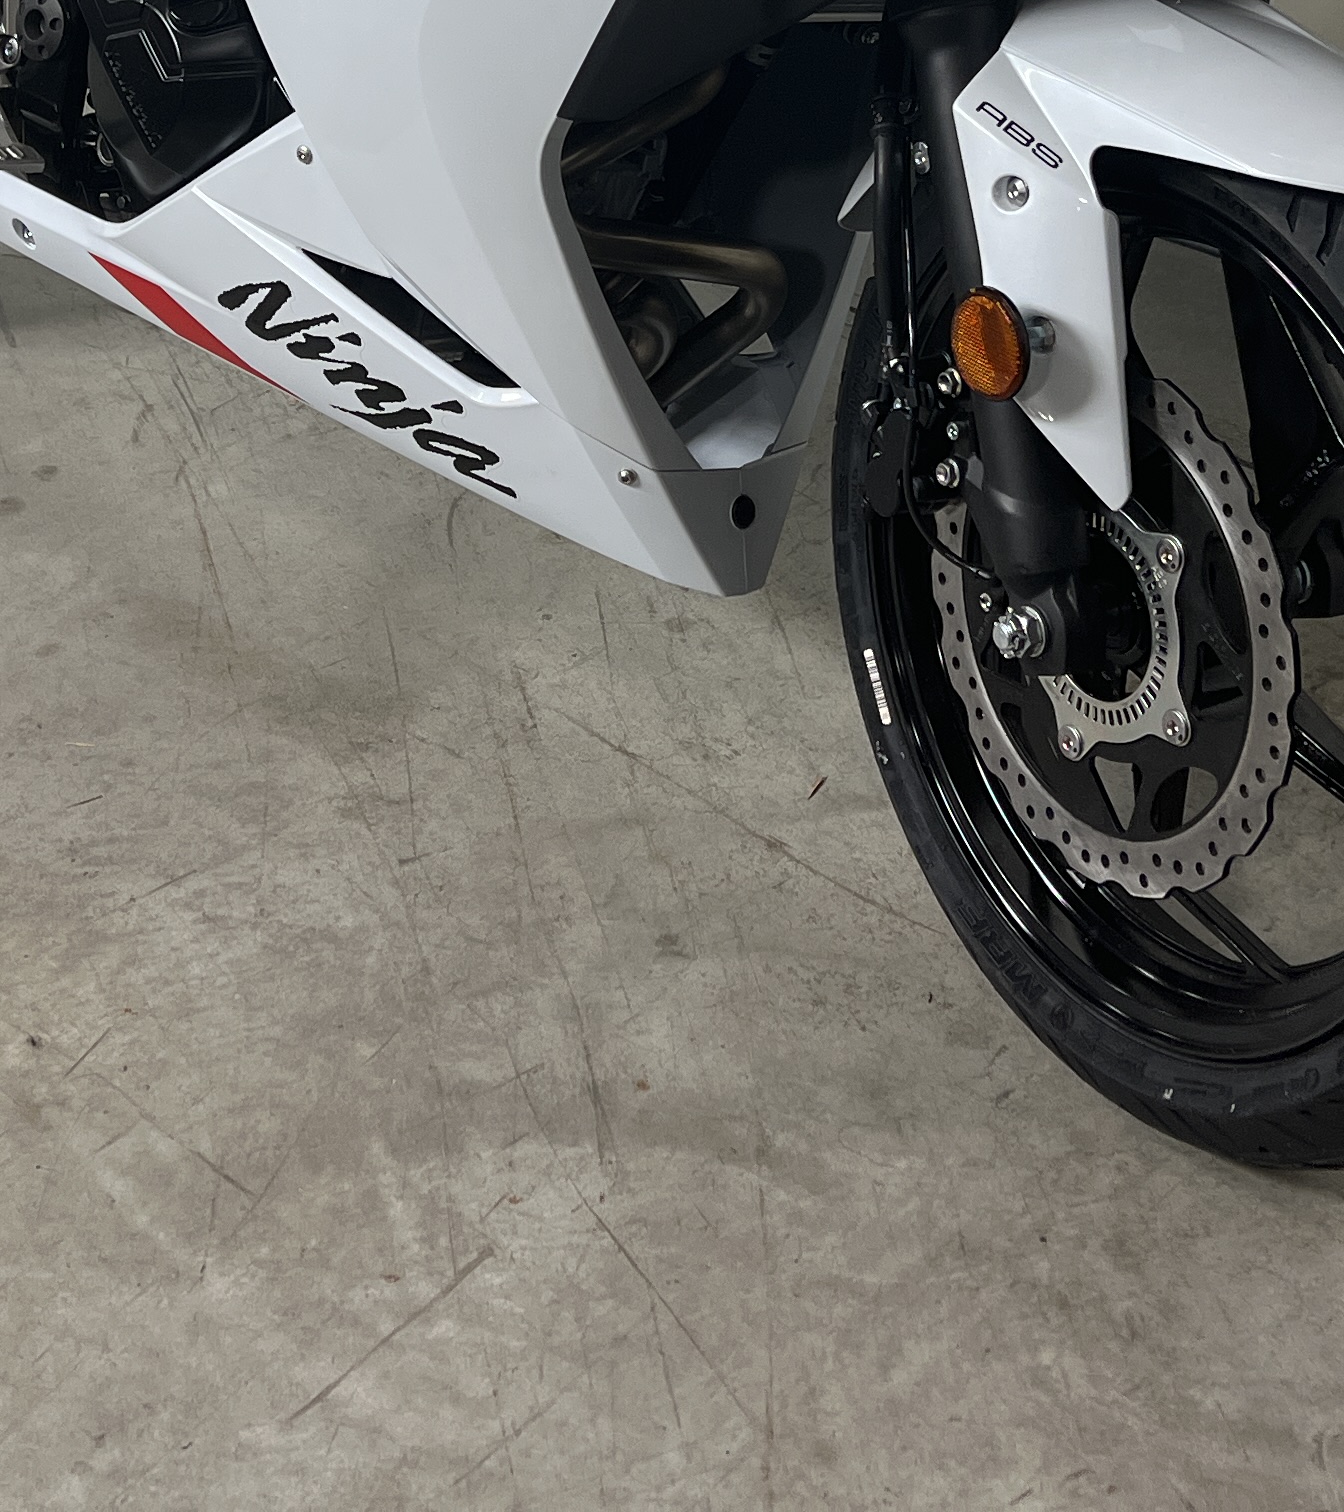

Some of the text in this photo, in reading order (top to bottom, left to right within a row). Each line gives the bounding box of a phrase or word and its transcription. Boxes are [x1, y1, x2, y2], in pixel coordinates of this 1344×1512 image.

[975, 101, 1063, 169] ABS
[217, 280, 517, 499] Ninja
[956, 901, 1049, 1001] MRF
